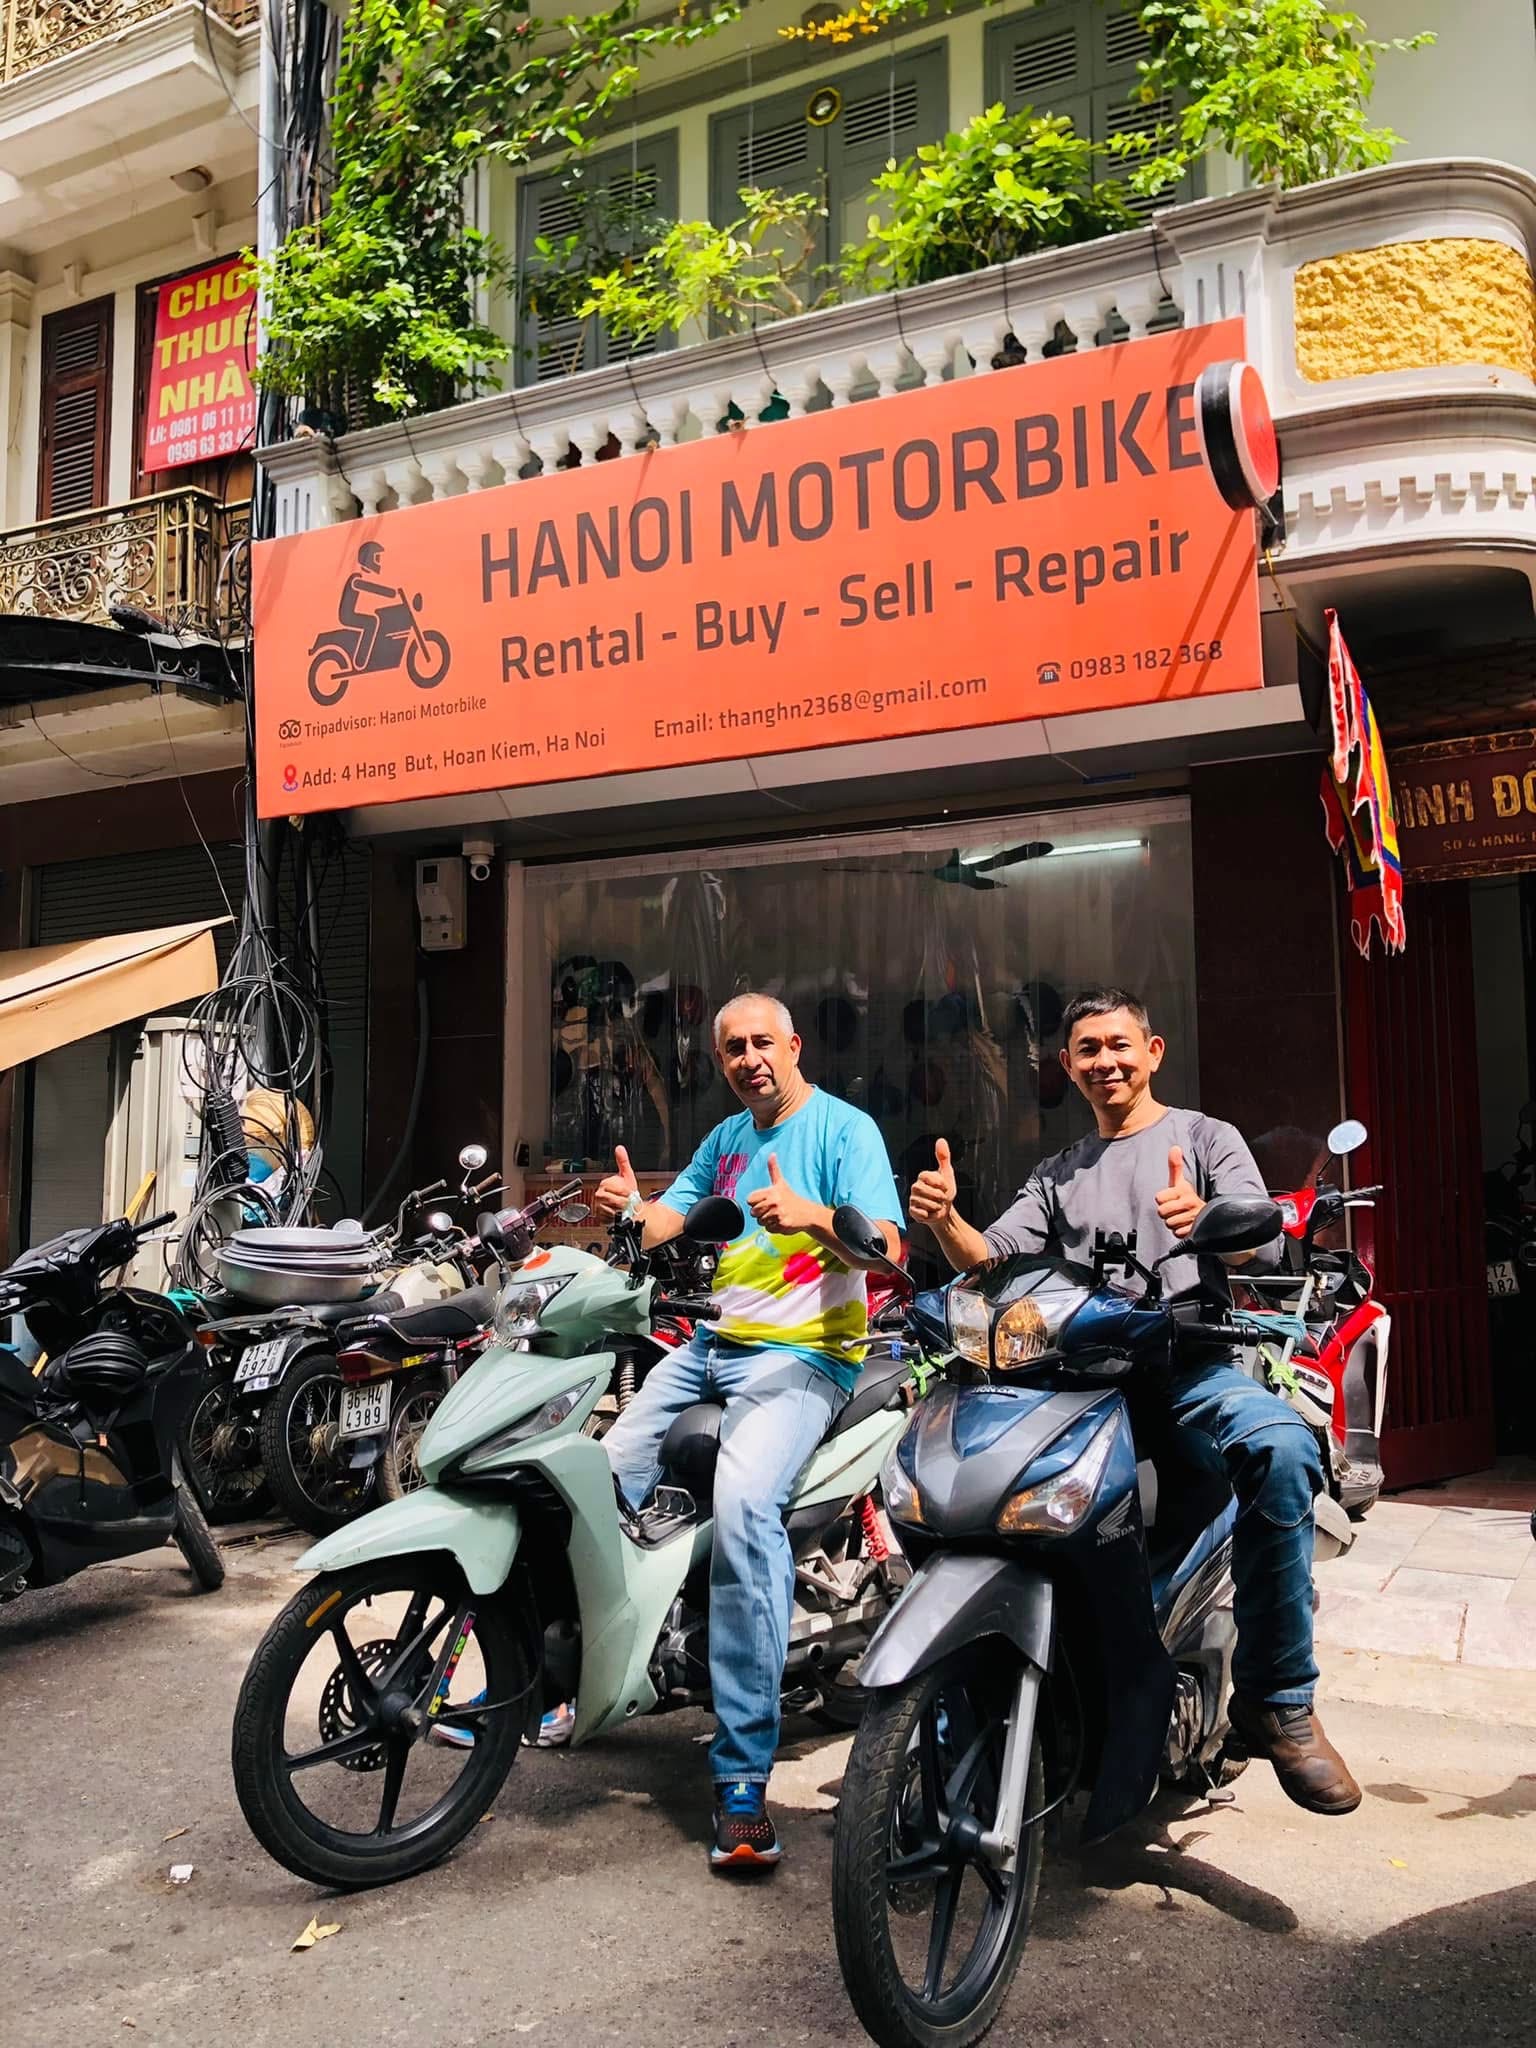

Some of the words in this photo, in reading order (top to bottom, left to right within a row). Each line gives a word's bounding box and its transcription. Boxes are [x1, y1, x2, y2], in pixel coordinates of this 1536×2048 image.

[169, 266, 251, 319] CHO
[157, 308, 257, 369] THUÊ
[159, 360, 245, 418] NHÀ
[220, 405, 234, 427] 11
[240, 401, 253, 422] 11
[167, 439, 197, 464] 0936
[199, 434, 215, 456] 63
[218, 430, 234, 452] 33
[480, 489, 693, 604] HANOI
[720, 381, 1203, 558] MOTORBIKE
[500, 611, 645, 684] Rental
[695, 600, 787, 655] Buy
[839, 559, 934, 628] Sell
[994, 518, 1190, 604] Repair
[1070, 654, 1126, 680] 0983
[1132, 647, 1175, 671] 182
[1179, 639, 1223, 666] 368
[304, 715, 377, 739] Tripadvisor:
[379, 705, 417, 725] Hanoi
[420, 695, 487, 719] Motorbike
[654, 711, 713, 739] Email:
[719, 677, 987, 730] thanghn2368@gmail.com
[301, 767, 337, 789] Add:
[341, 765, 352, 782] 4
[355, 761, 397, 781] Hang
[405, 753, 438, 773] But,
[443, 749, 486, 768] Hoan
[491, 740, 541, 761] Kiem,
[546, 734, 570, 753] Ha
[575, 727, 605, 749] Noi
[1394, 780, 1474, 828] ÌNH
[1096, 1524, 1136, 1547] HONDA
